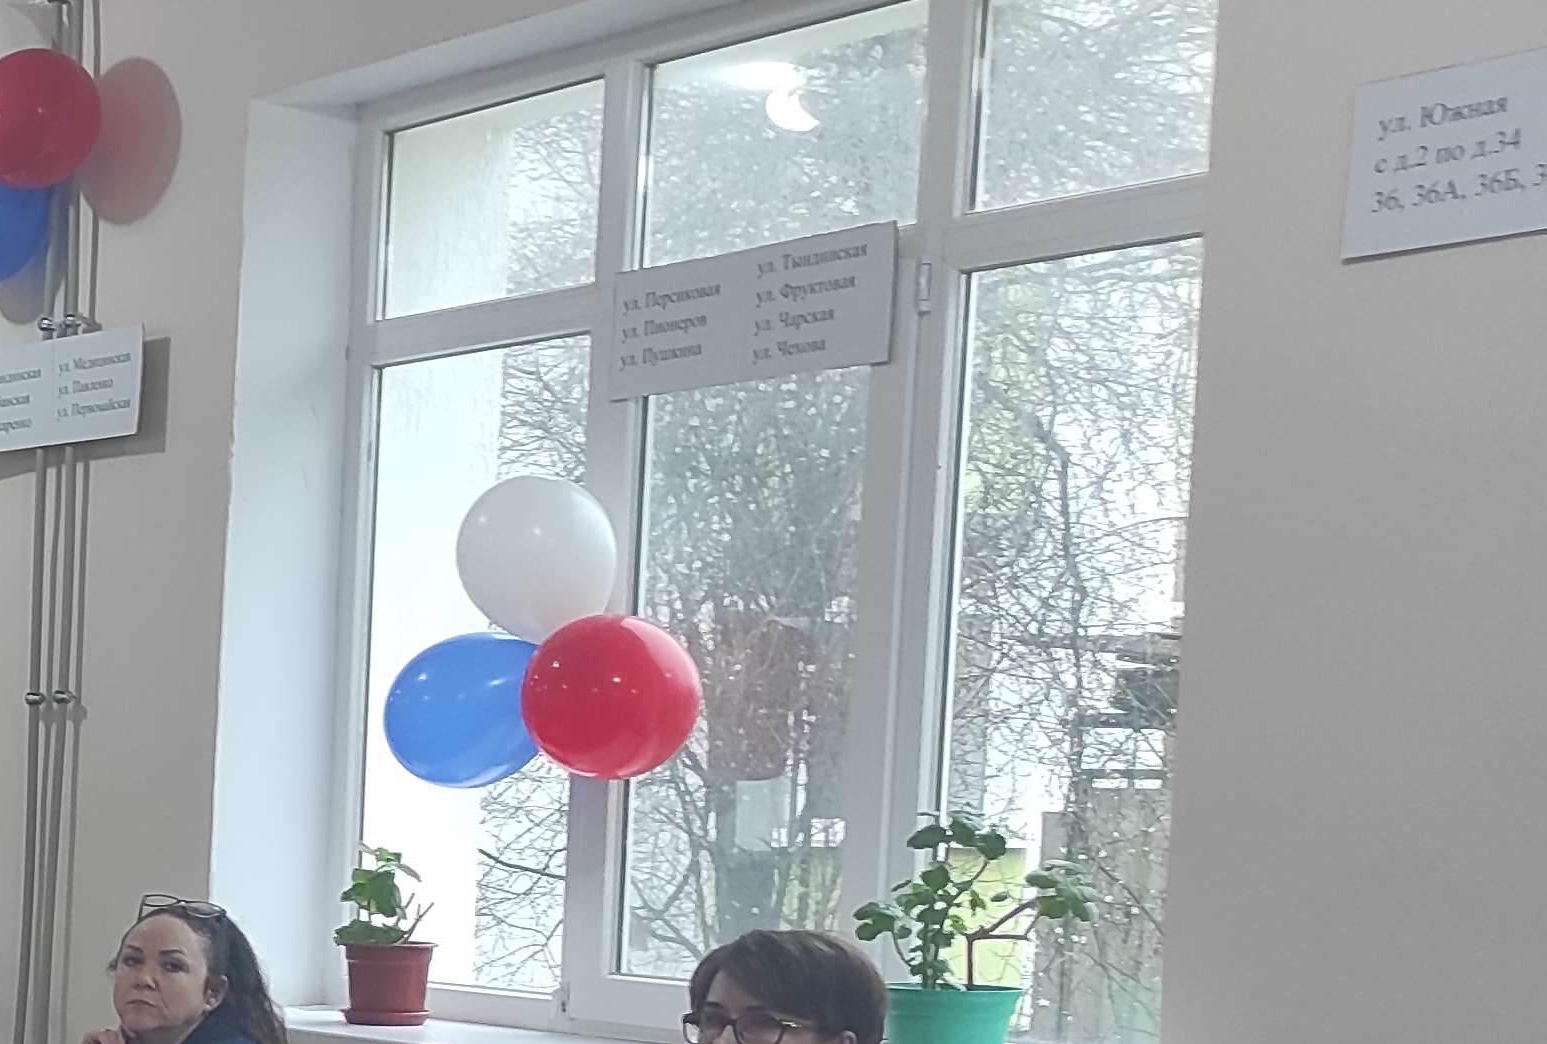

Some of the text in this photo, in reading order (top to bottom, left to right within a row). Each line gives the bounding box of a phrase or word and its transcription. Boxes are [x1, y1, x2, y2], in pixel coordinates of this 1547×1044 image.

[1379, 97, 1508, 142] ул. Южная
[1435, 145, 1465, 164] по
[756, 261, 777, 279] ул.
[622, 284, 721, 316] ул. Персиковая
[755, 276, 855, 308] ул. Фруктовая
[621, 315, 708, 344] ул. Пионеров
[754, 319, 775, 337] ул.
[620, 343, 702, 371] ул. Пушкина
[752, 339, 826, 365] ул. Чехова
[56, 408, 69, 422] ул.
